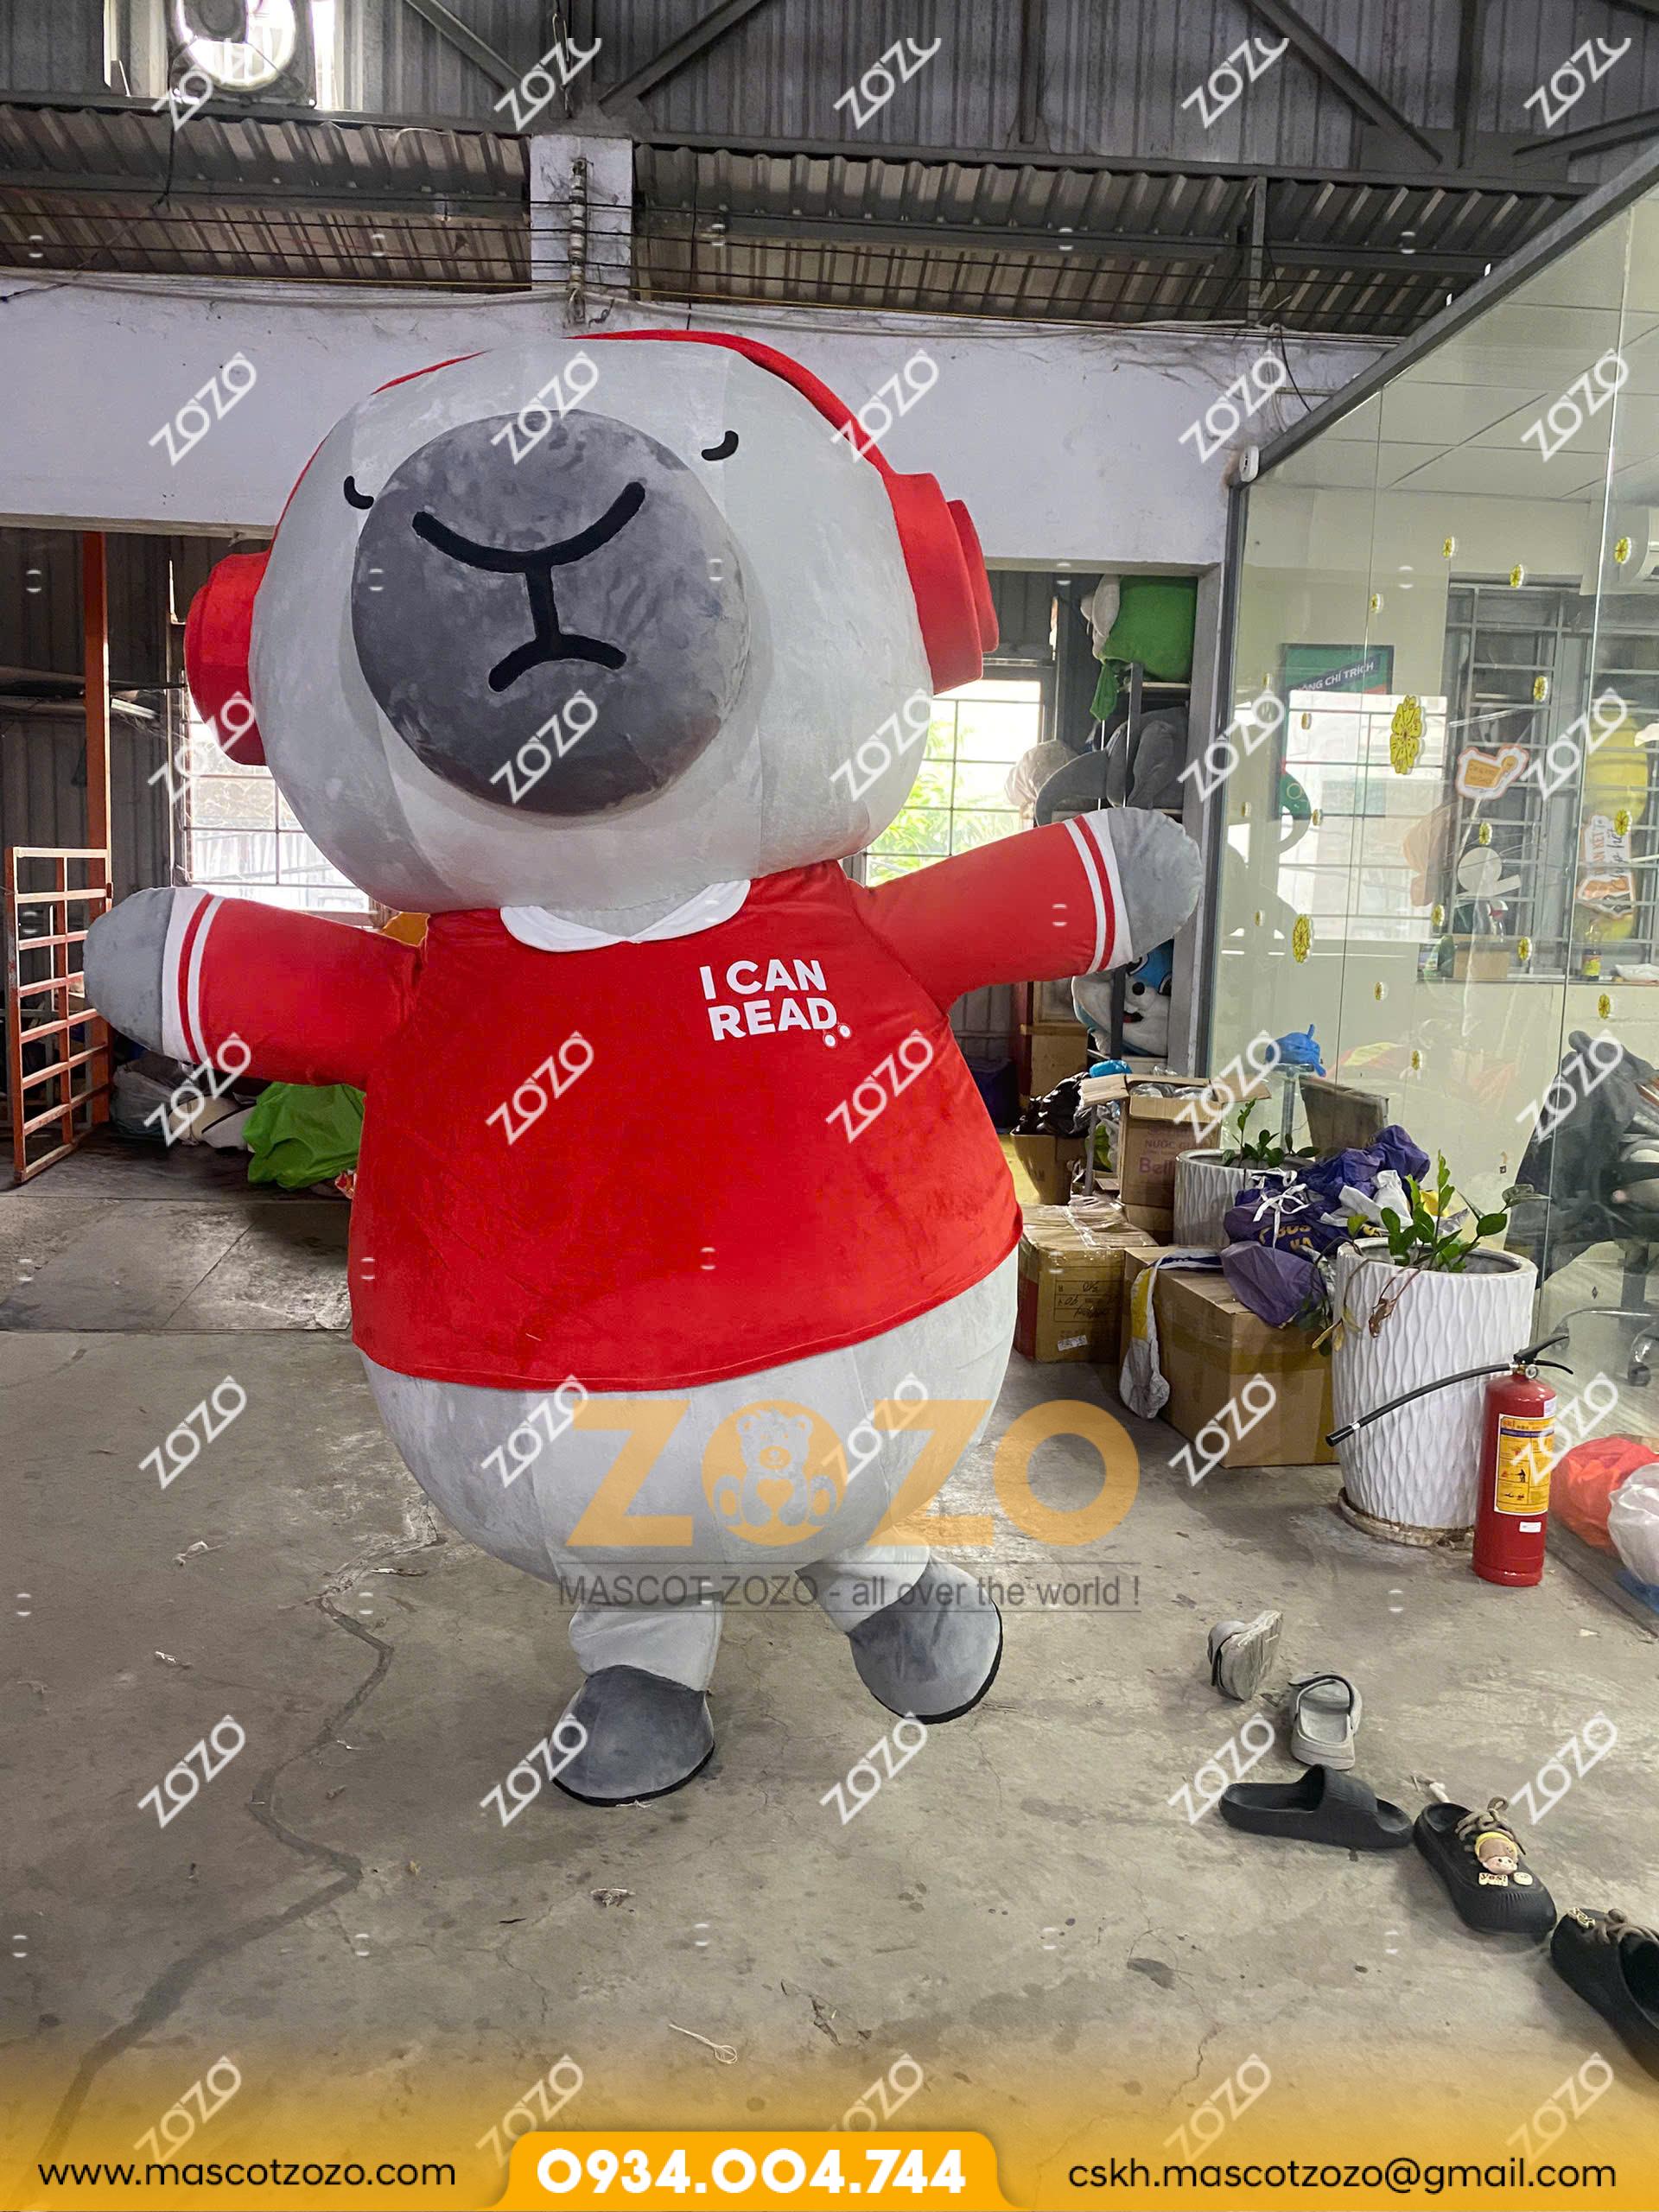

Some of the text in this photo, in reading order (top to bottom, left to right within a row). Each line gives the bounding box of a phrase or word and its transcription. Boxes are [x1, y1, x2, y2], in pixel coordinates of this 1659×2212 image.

[699, 958, 827, 1000] I CAN
[708, 997, 837, 1041] READ
